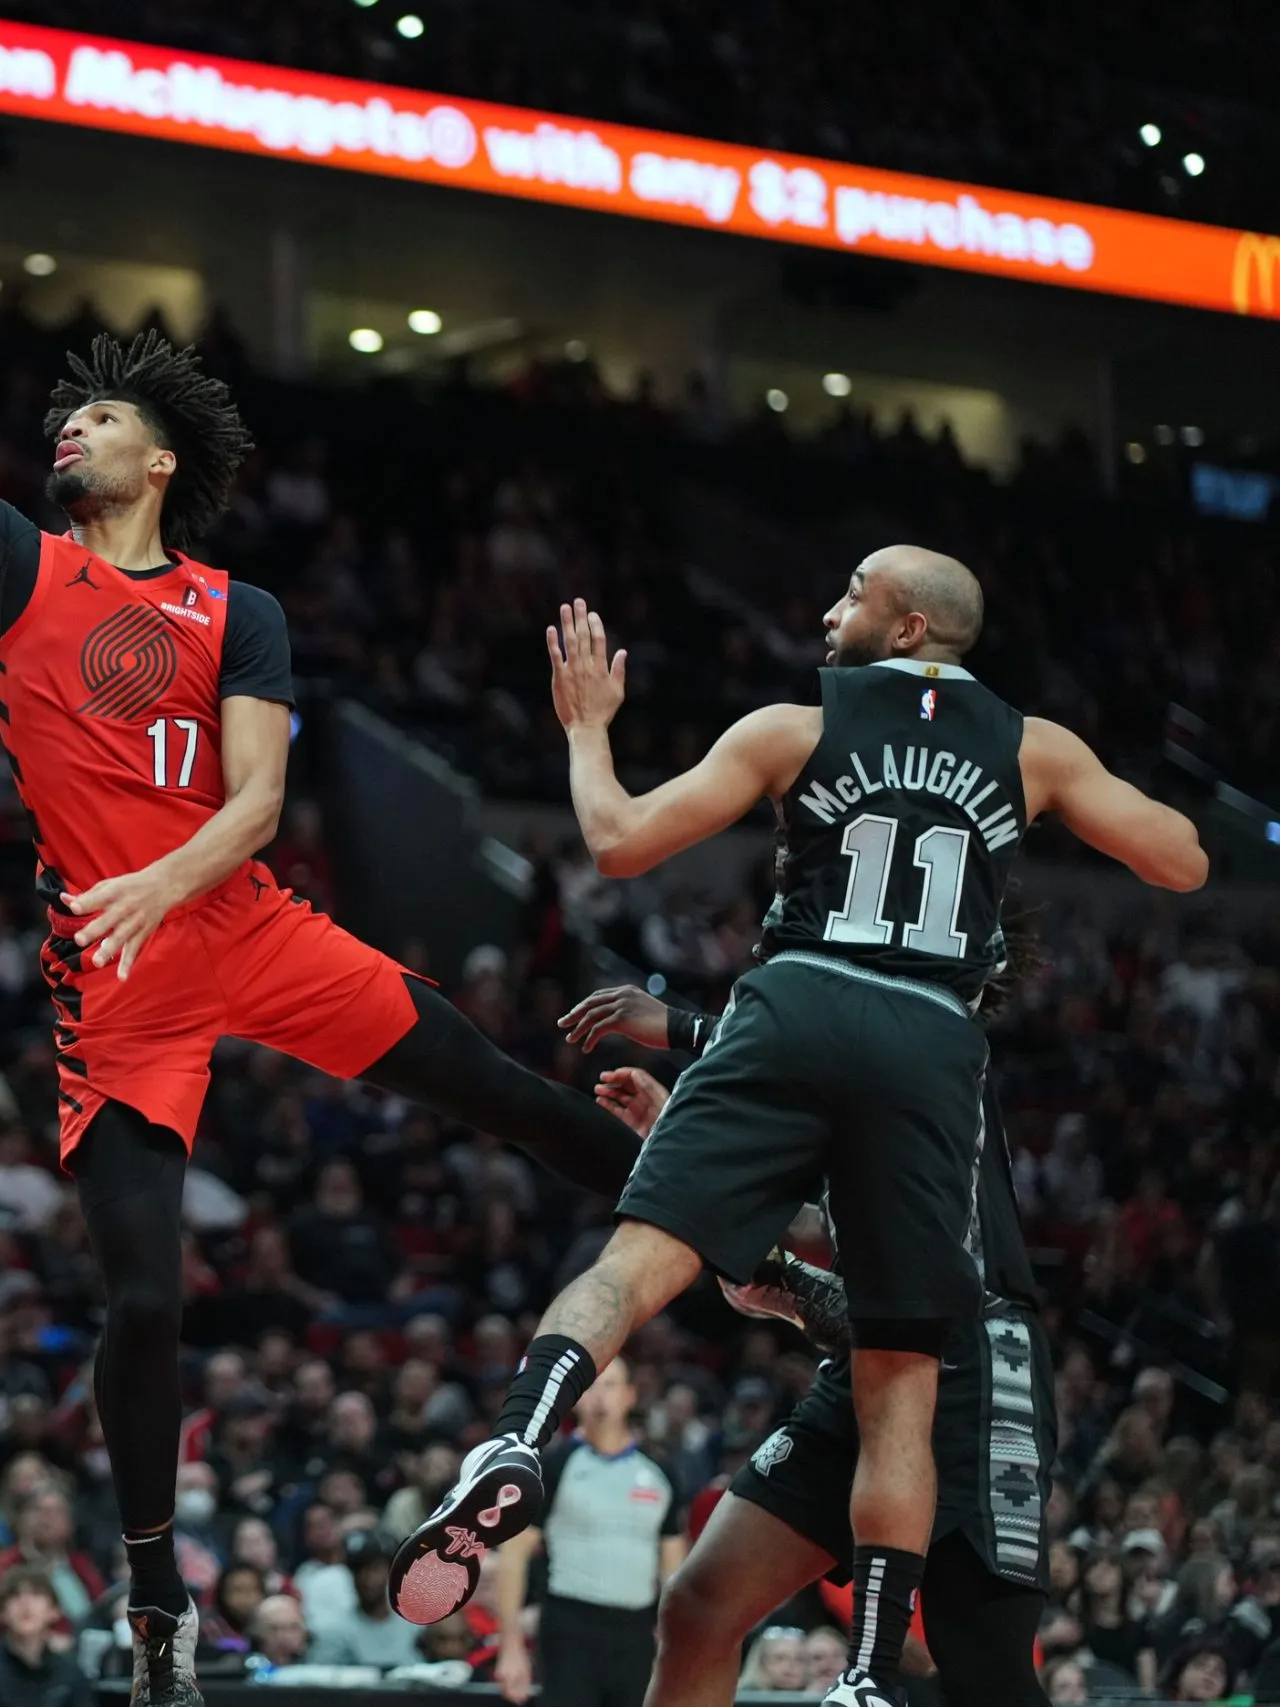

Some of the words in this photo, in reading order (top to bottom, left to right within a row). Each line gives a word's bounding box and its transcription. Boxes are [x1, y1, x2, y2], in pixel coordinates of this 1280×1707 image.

[483, 120, 622, 193] with
[629, 152, 743, 223] any
[747, 158, 829, 228] $2
[834, 186, 1096, 272] purchase
[160, 602, 211, 625] BRIGHTSIDE
[146, 717, 199, 787] 17
[798, 744, 1019, 853] McLAUGHLIN
[823, 813, 971, 959] 11
